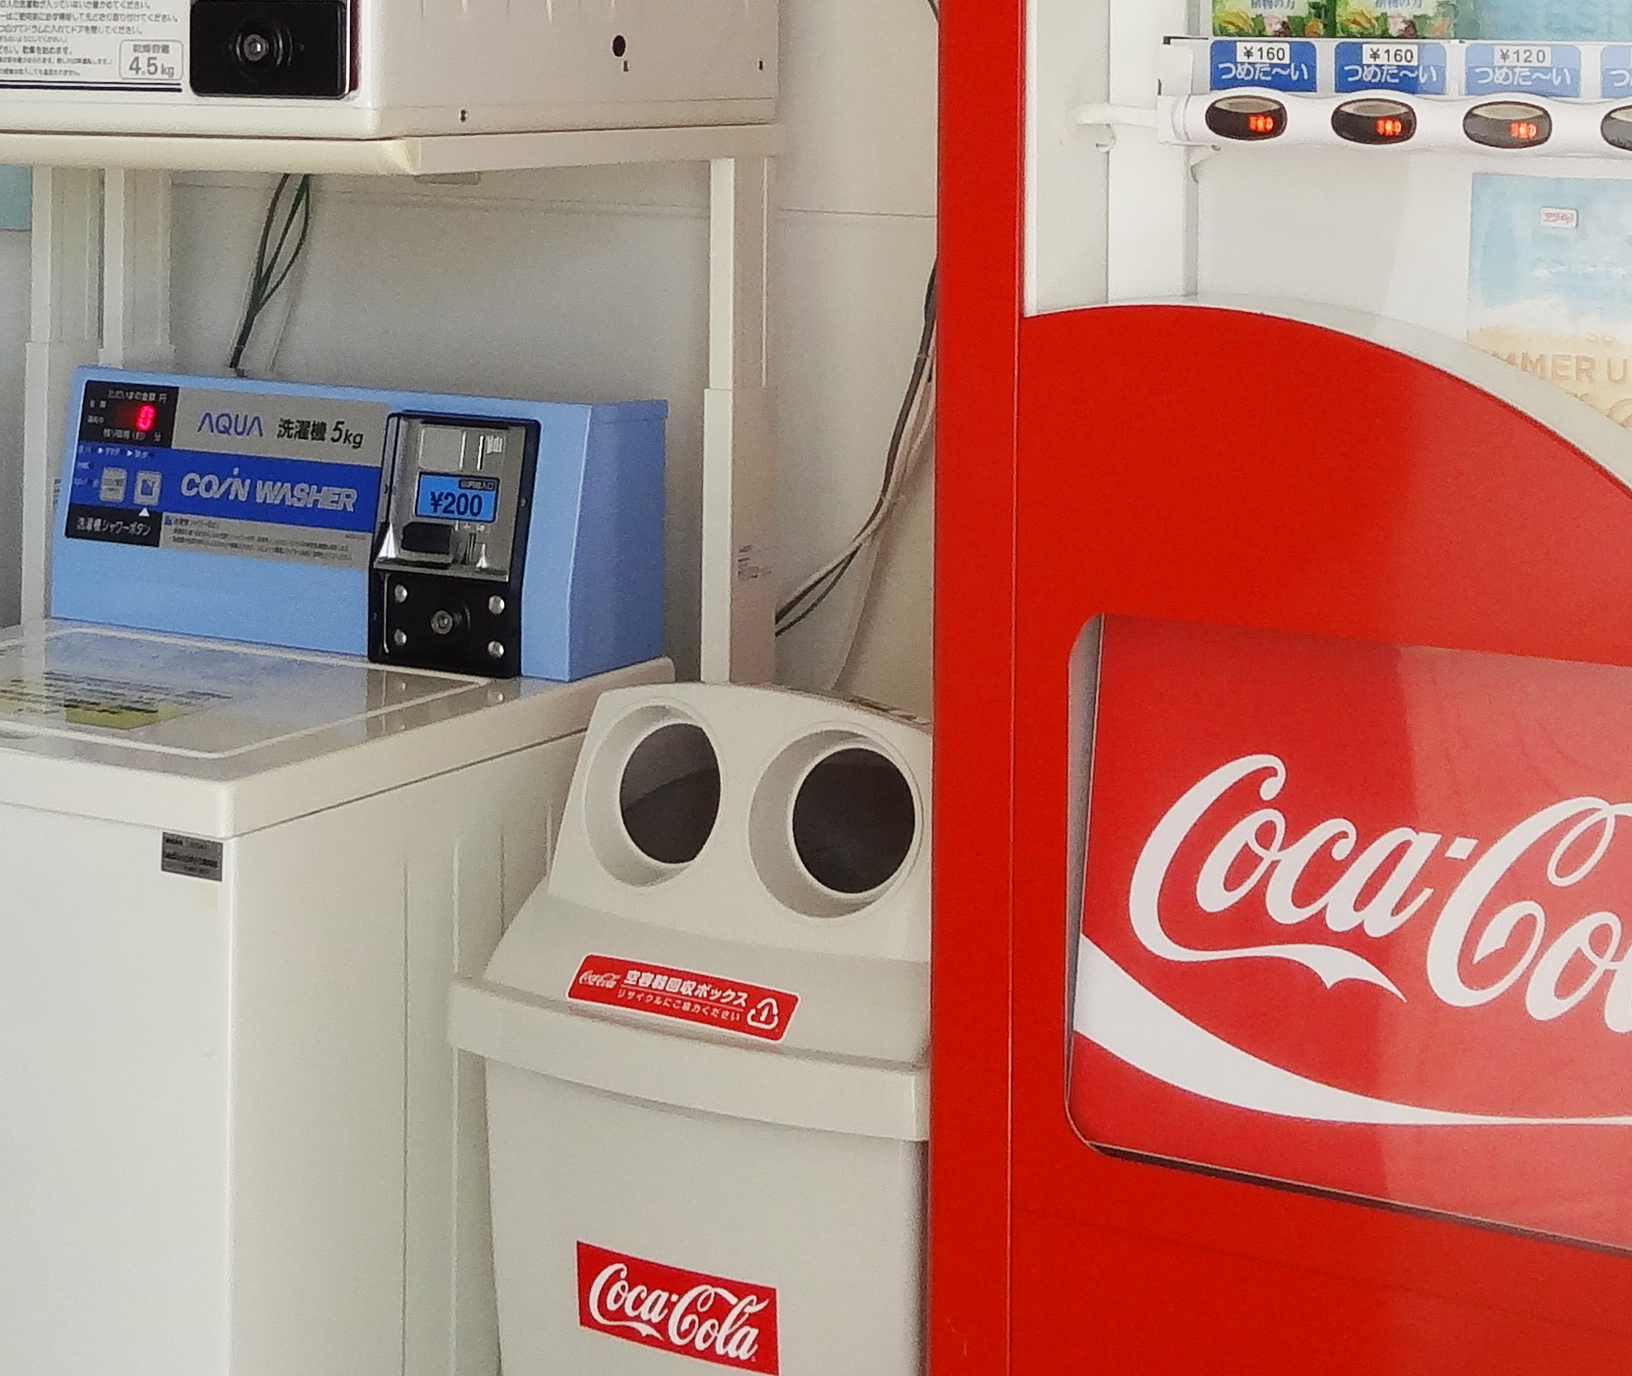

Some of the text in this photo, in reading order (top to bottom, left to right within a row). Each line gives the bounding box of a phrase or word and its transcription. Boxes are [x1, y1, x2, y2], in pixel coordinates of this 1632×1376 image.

[1243, 46, 1286, 62] ¥160
[1369, 47, 1415, 64] ¥160
[1499, 48, 1546, 64] ¥120
[136, 405, 156, 431] 0
[197, 412, 264, 437] AQUA
[277, 418, 364, 449] 洗濯機 5kg
[256, 482, 358, 512] WASHER
[430, 490, 484, 517] ¥200
[624, 969, 748, 1007] 空容器回収ボックス
[617, 989, 742, 1022] リサイクルにご協力ください
[588, 1262, 770, 1362] Coca-Cola
